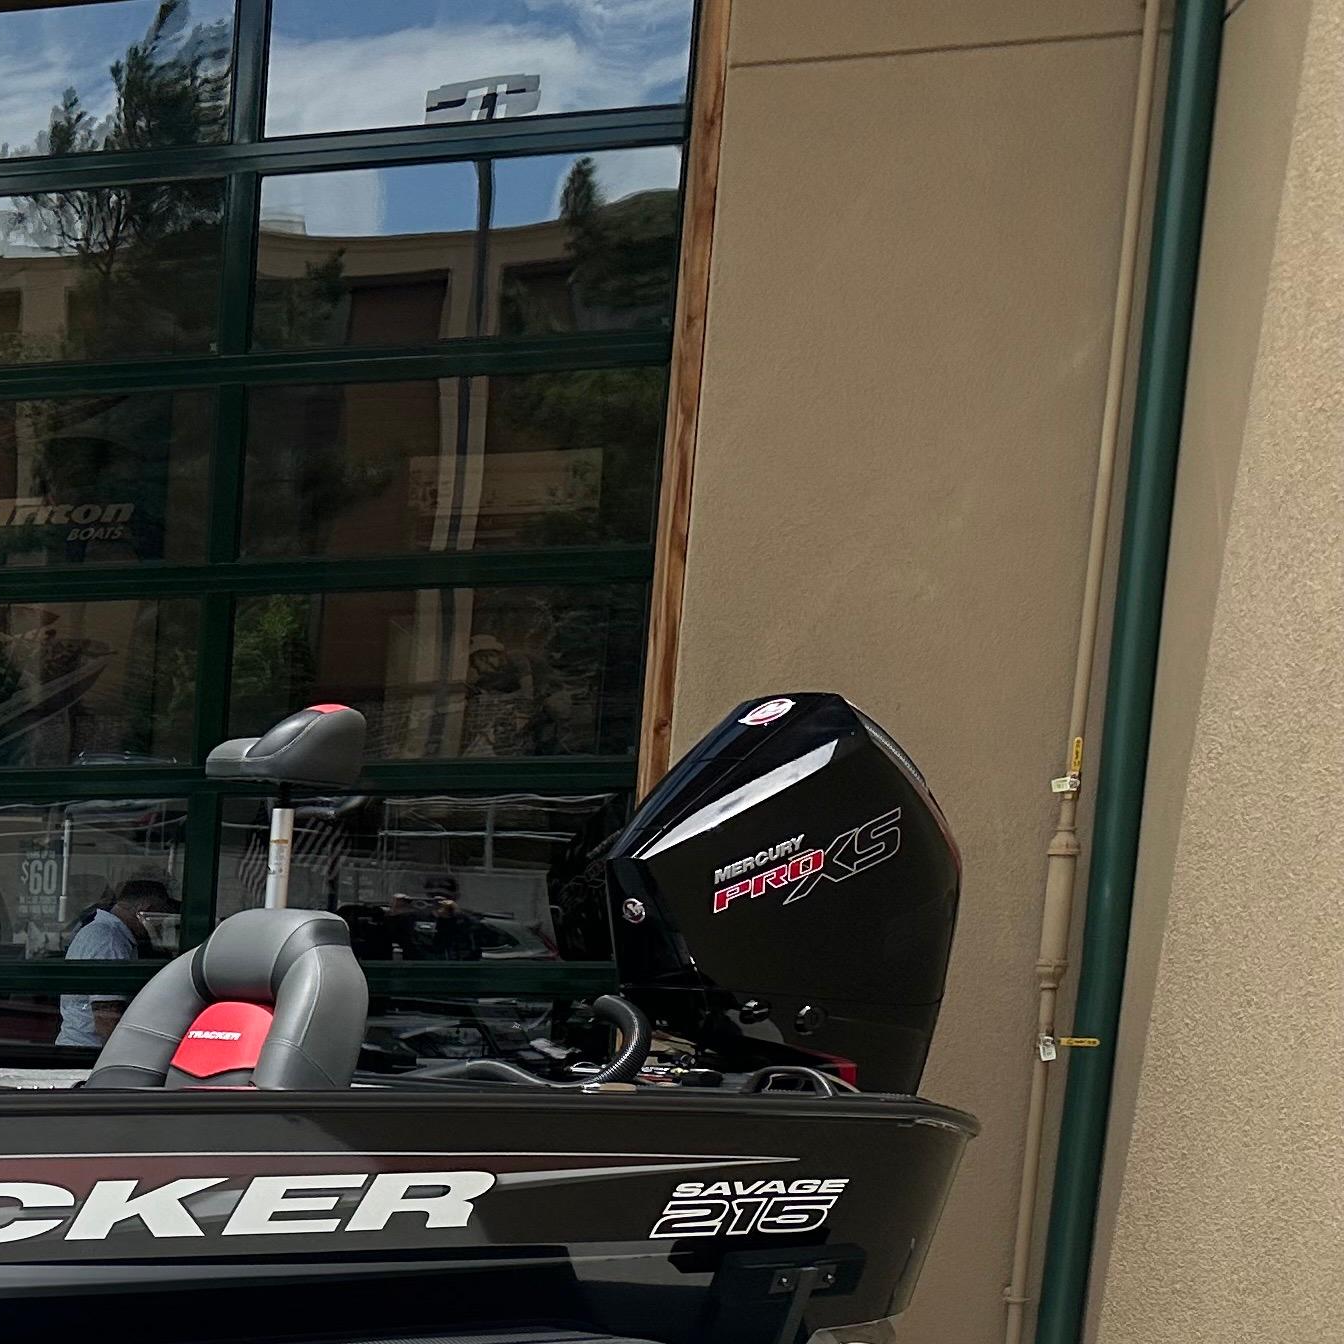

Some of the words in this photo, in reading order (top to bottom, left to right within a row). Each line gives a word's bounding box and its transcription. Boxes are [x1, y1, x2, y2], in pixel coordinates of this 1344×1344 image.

[67, 527, 124, 541] BOATS
[714, 834, 805, 885] MERCURY
[672, 1178, 850, 1198] SAVAGE
[648, 1195, 839, 1239] 215
